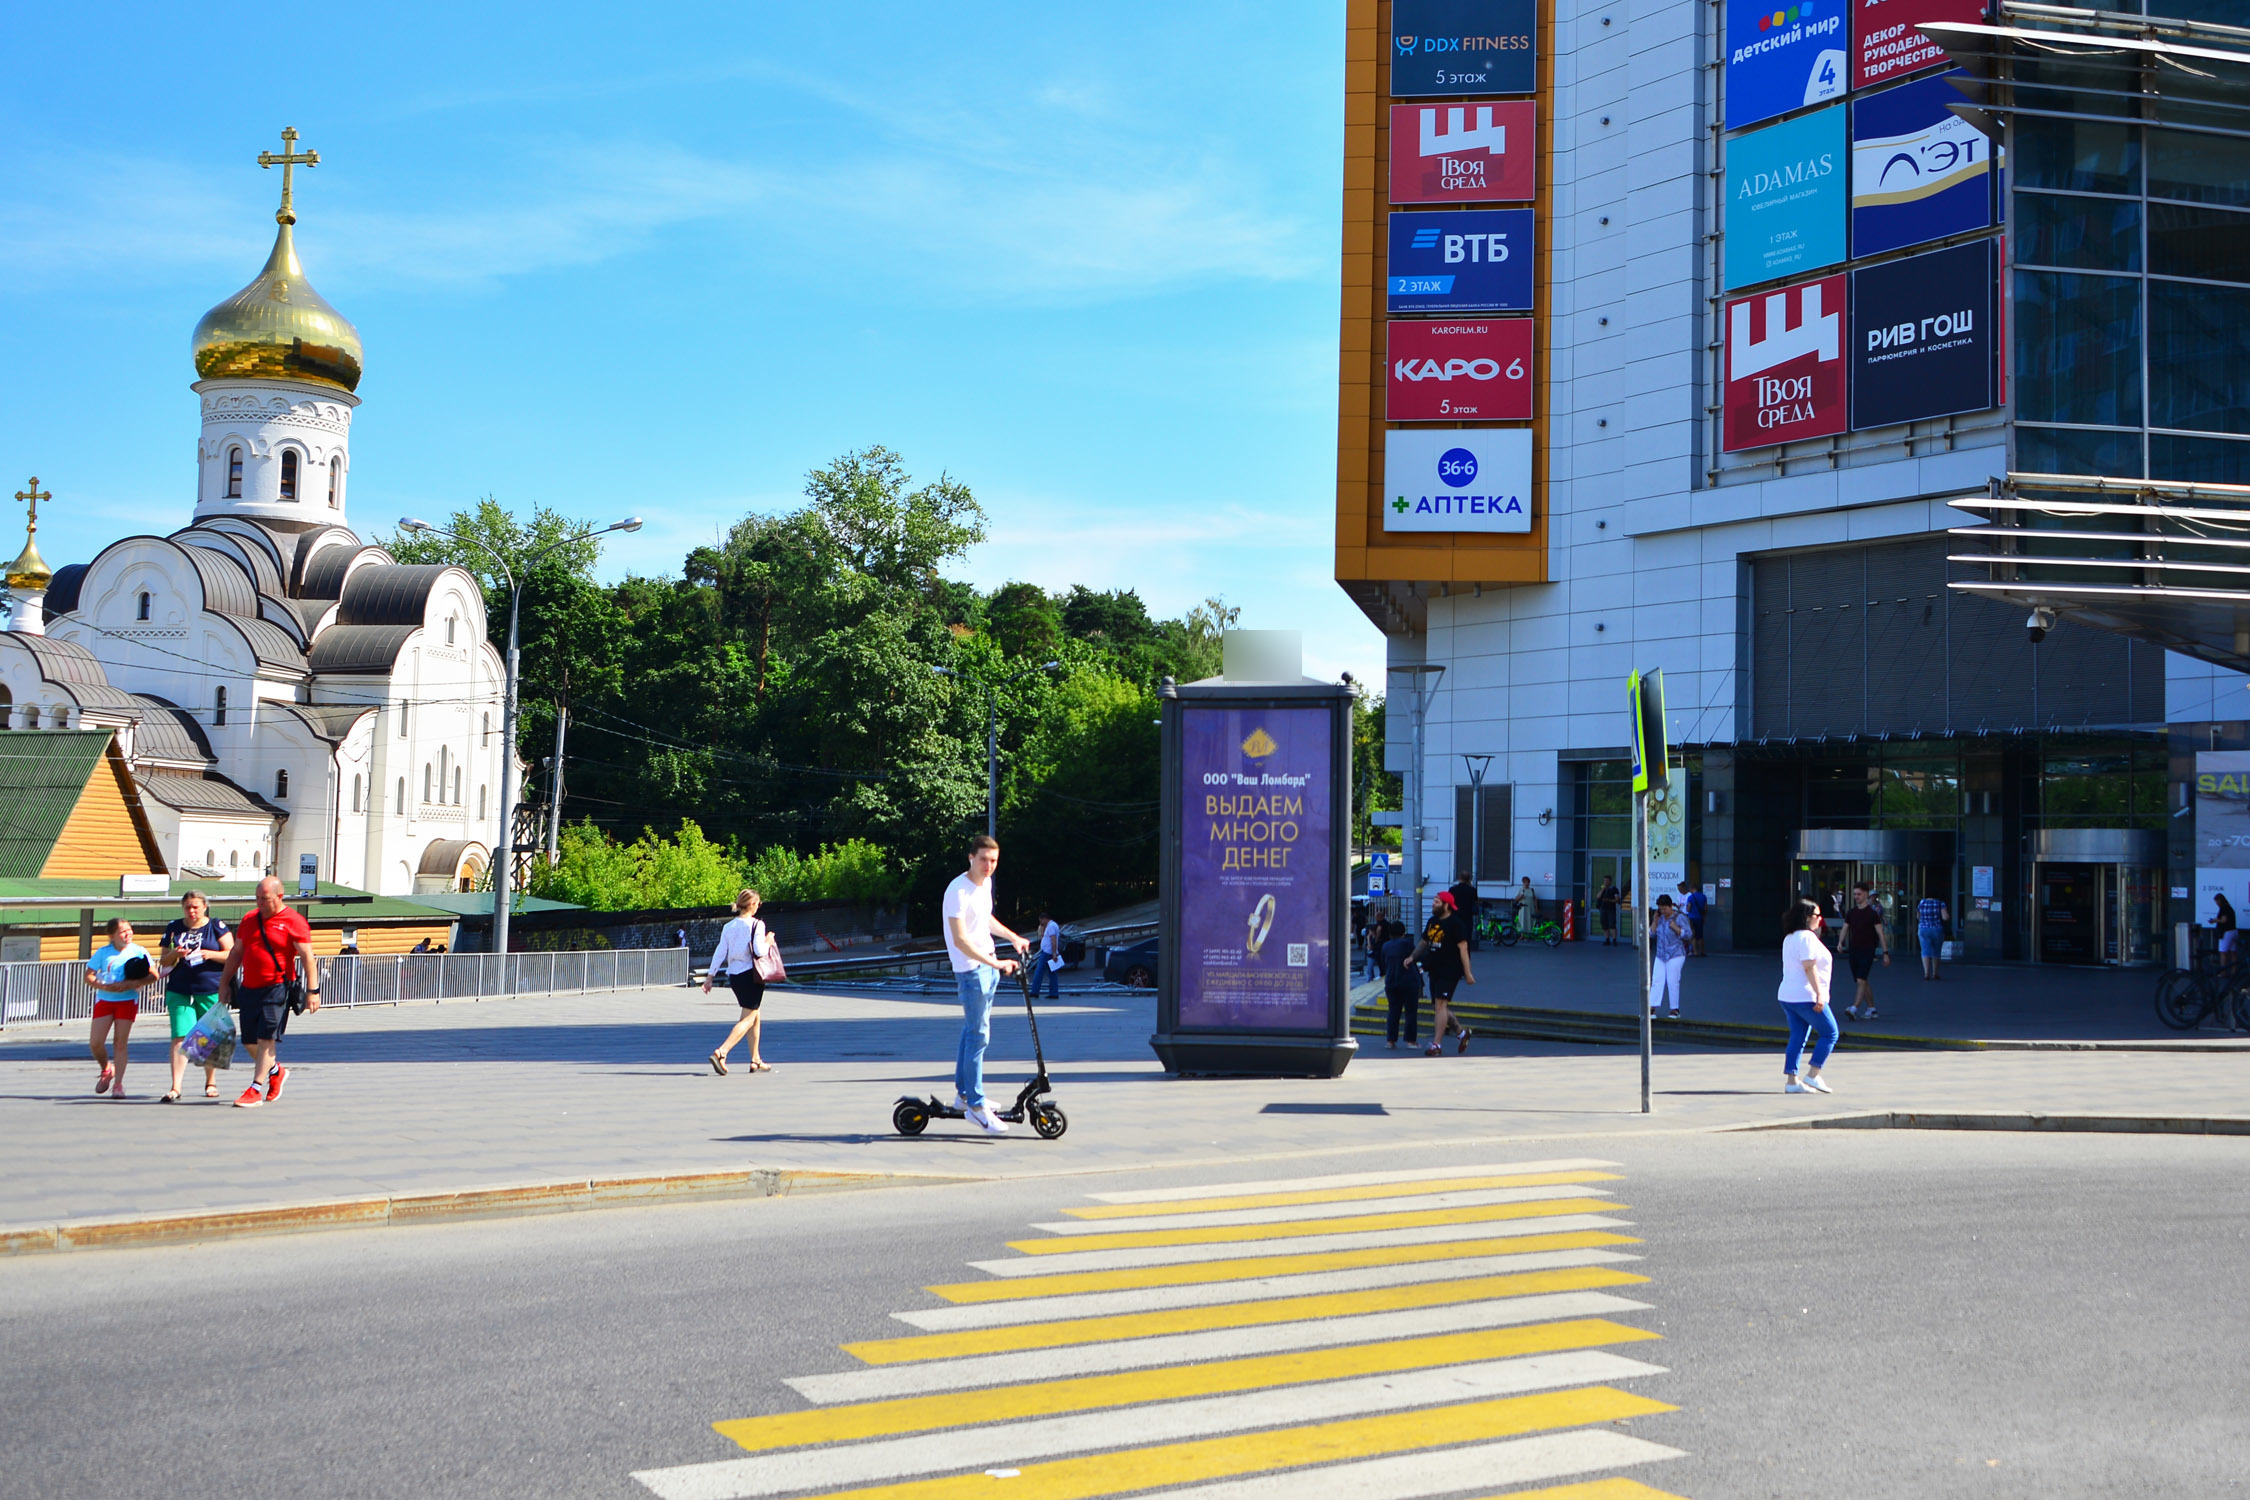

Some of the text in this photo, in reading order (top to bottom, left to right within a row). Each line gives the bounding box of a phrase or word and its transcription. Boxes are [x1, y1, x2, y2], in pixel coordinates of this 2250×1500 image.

[1424, 36, 1529, 52] DDX FITNESS
[1733, 16, 1840, 64] детский мир
[1864, 24, 1906, 48] ДЕКОР
[1864, 34, 1930, 62] РУКОДЕЛИ
[1436, 70, 1487, 84] 5 этаж
[1818, 59, 1835, 85] 4
[1818, 86, 1836, 96] этаж
[1441, 176, 1487, 190] СРЕДА
[1738, 153, 1832, 200] ADAMAS
[1444, 233, 1509, 263] ВТБ
[1776, 230, 1798, 243] ЭТАЖ
[1398, 280, 1441, 292] 2 ЭТАЖ
[1432, 326, 1488, 334] KAROFILM.RU
[1868, 310, 1972, 351] РИВ ГОШ
[1868, 348, 1917, 364] ПАРФЮМЕРИЯ
[1928, 337, 1972, 352] КОСМЕТИКА
[1395, 358, 1524, 382] КАРО 6
[1440, 399, 1478, 414] 5 этаж
[1757, 401, 1815, 428] СРЕДА
[1416, 496, 1522, 514] АПТЕКА
[1203, 772, 1311, 788] ООО "Ваш Ломбард"
[1206, 795, 1303, 819] ВЫДАЕМ
[1210, 821, 1298, 842] МНОГО
[1222, 847, 1292, 871] ДЕНЕГ
